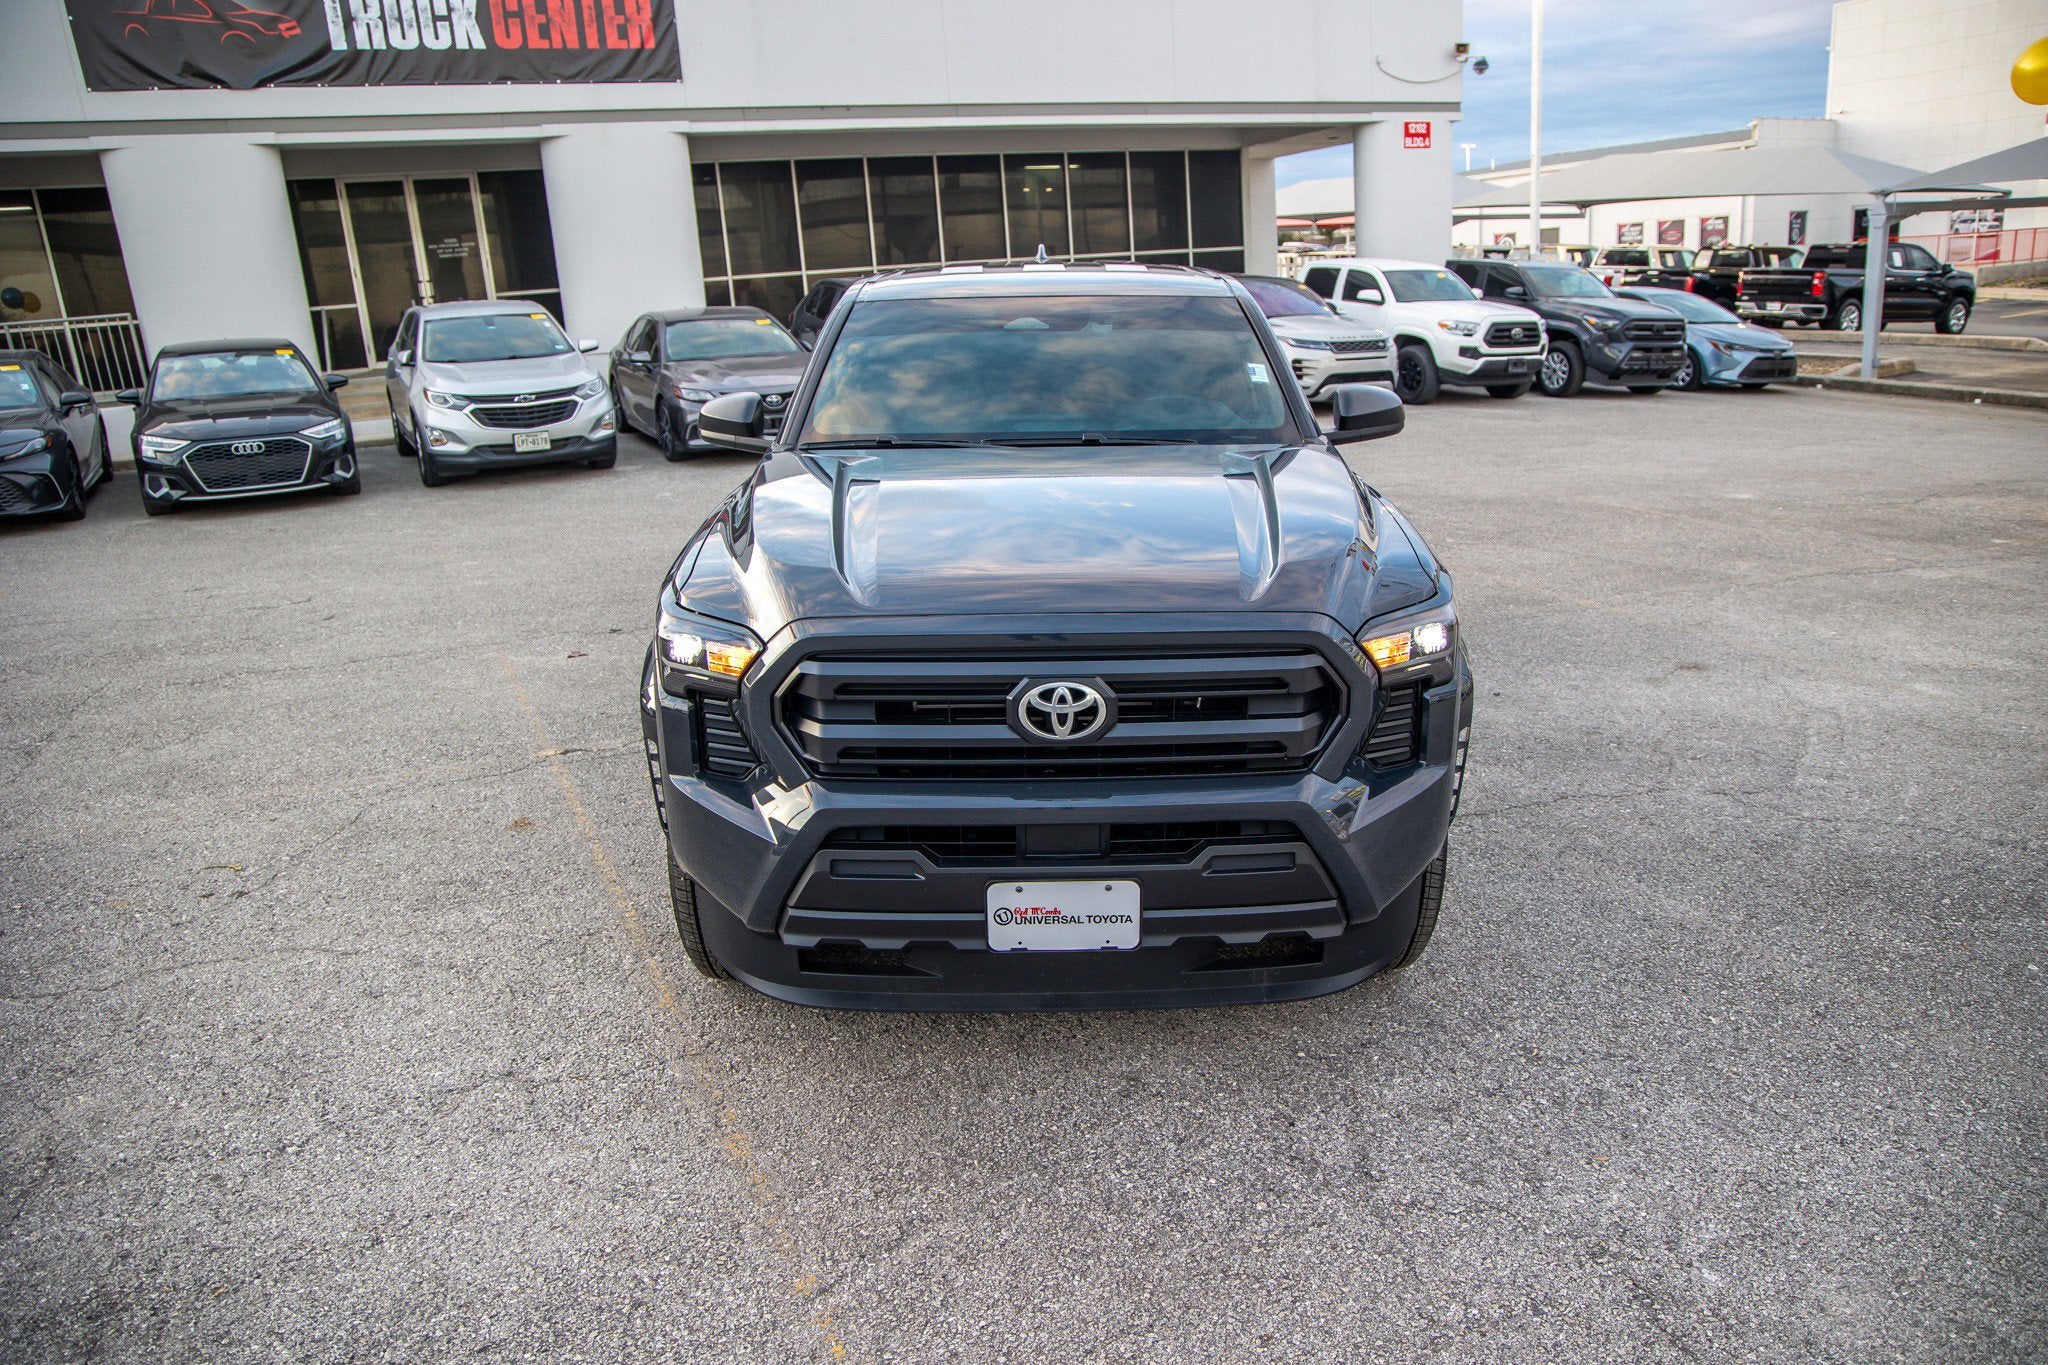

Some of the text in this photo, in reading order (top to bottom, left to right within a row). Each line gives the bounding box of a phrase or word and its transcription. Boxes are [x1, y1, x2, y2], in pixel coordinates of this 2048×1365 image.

[323, 0, 657, 50] TRUCK CENTER
[1014, 907, 1028, 918] Red
[1014, 914, 1133, 925] UNIVERSAL TOYOTA
